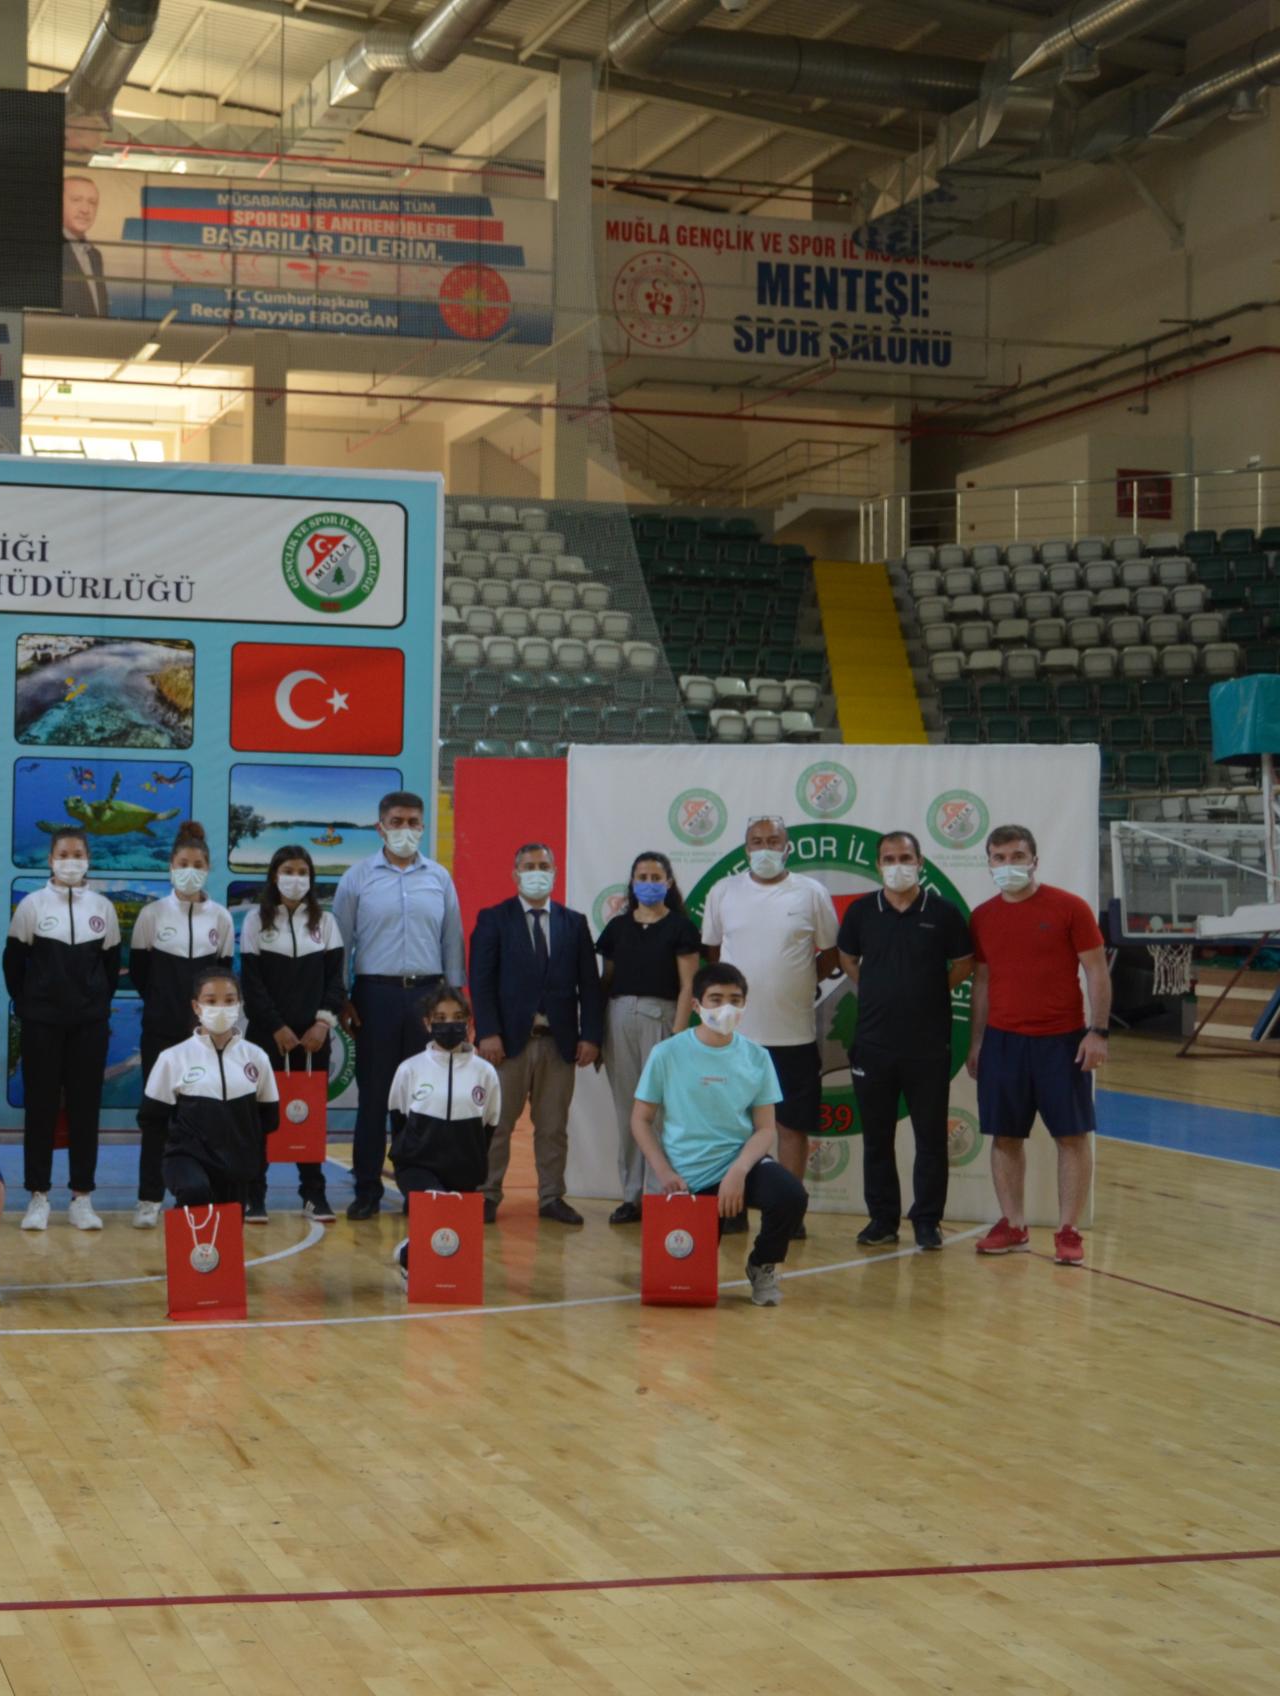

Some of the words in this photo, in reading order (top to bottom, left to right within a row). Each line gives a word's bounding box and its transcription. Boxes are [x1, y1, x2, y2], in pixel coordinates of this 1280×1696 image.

[340, 197, 400, 213] KATILAN
[403, 198, 437, 214] TÜM
[232, 209, 301, 228] SPORCU
[330, 215, 457, 240] ANTRENÖRLERE
[605, 216, 670, 245] MUĞLA
[676, 224, 754, 256] GENÇLİK
[761, 231, 783, 254] VE
[787, 234, 836, 259] SPOR
[841, 233, 860, 261] İL
[340, 232, 444, 262] DİLERİM.
[756, 261, 930, 325] MENTEŞE
[248, 306, 306, 325] Tayyip
[309, 307, 399, 329] ERDOĞAN
[733, 314, 821, 358] SPOR
[829, 321, 953, 368] SALONU
[308, 515, 338, 529] SPOR
